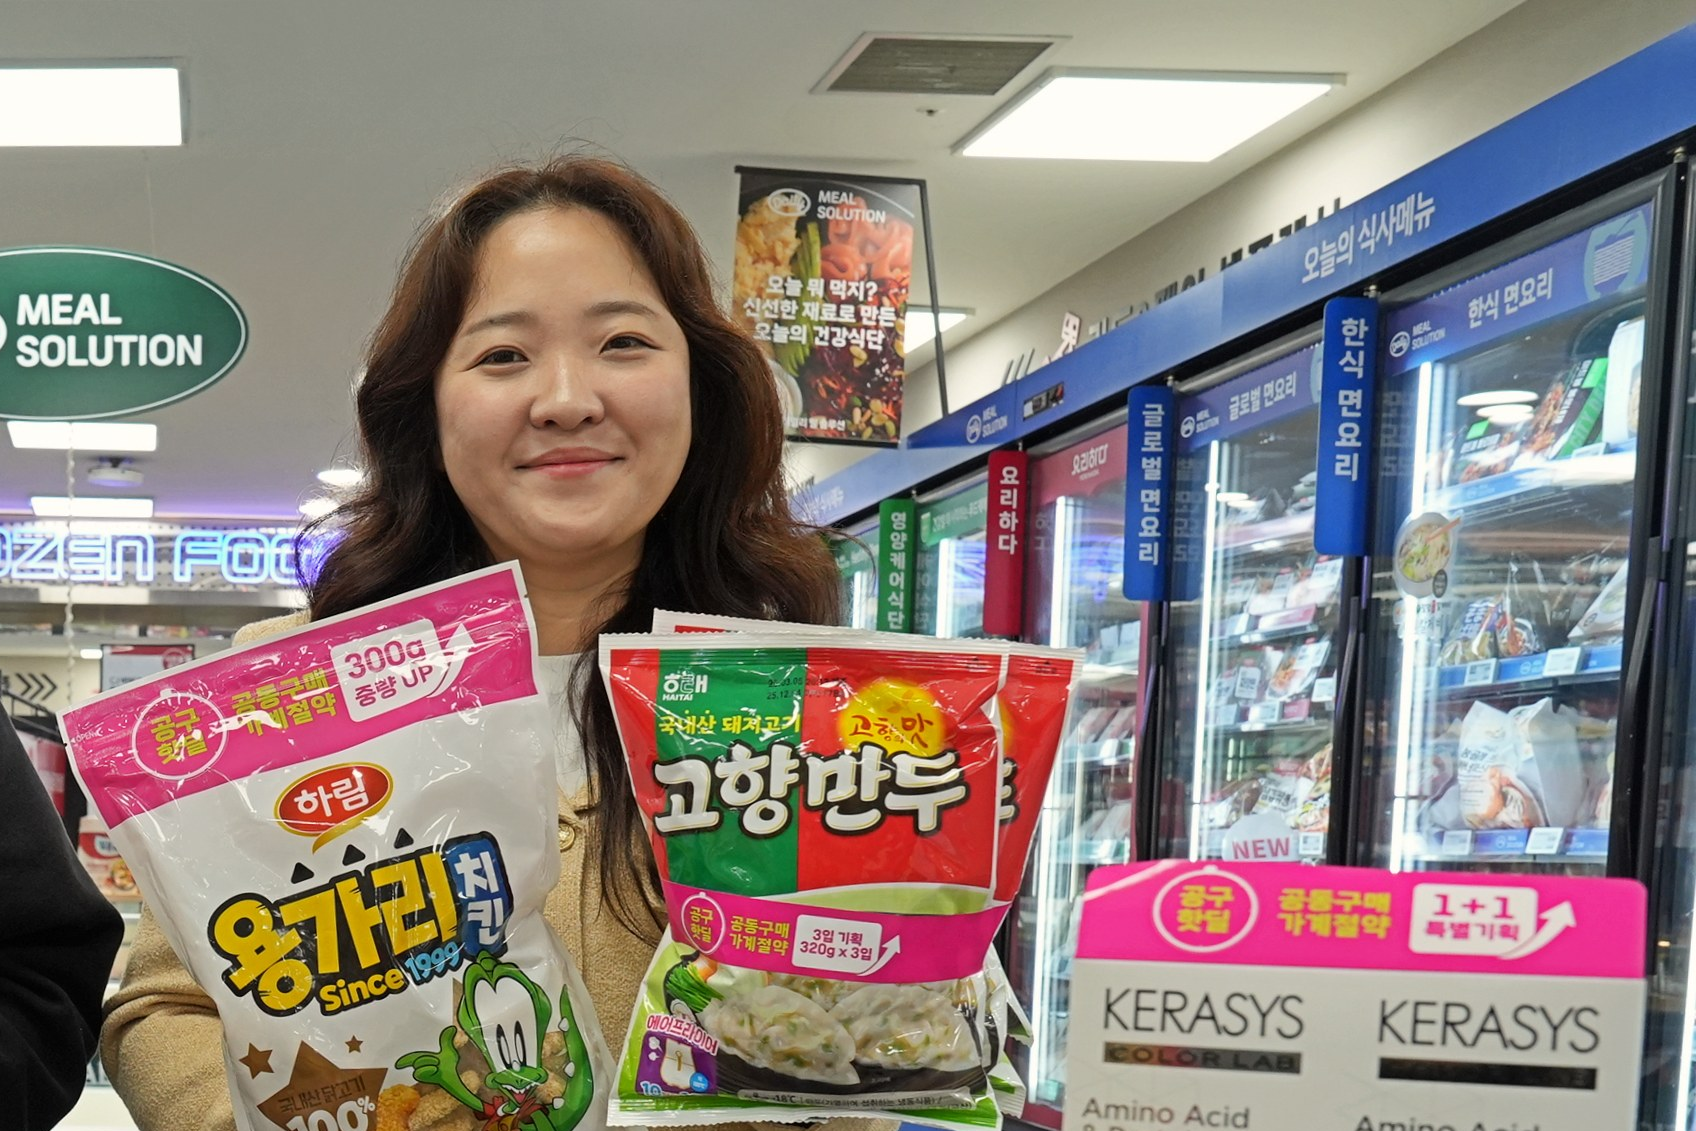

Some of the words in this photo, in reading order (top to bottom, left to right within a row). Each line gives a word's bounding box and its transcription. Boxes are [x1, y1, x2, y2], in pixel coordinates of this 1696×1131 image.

[818, 189, 856, 205] MEAL
[816, 206, 887, 223] SOLUTION
[1300, 224, 1355, 284] 오늘의
[1357, 191, 1436, 256] 식사메뉴
[765, 275, 803, 297] 오늘
[806, 278, 825, 299] 뭐
[829, 278, 878, 302] 먹지?
[1467, 289, 1500, 330] 한식
[1503, 267, 1554, 314] 면요리
[15, 293, 122, 326] MEAL
[742, 297, 799, 320] 신선한
[802, 301, 857, 323] 재료로
[860, 303, 897, 328] 만든
[753, 322, 808, 344] 오늘의
[813, 324, 886, 350] 건강식단
[1411, 327, 1446, 350] SOLUTION
[1412, 320, 1431, 335] MEAL
[15, 333, 203, 368] SOLUTION
[1338, 316, 1369, 380] 한식
[1140, 402, 1166, 482] 글로벌
[1334, 389, 1363, 482] 면요리
[998, 465, 1020, 555] 요리하다
[1138, 488, 1162, 566] 면요리
[887, 510, 908, 631] 영양케어식단
[402, 662, 435, 690] UP
[662, 693, 694, 701] HAITAI
[659, 712, 716, 736] 국내산
[292, 776, 374, 820] 하림
[652, 741, 970, 838] 고향만두
[1232, 836, 1291, 860] NEW
[453, 851, 501, 948] 치킨
[1178, 884, 1234, 909] 공구
[1277, 886, 1392, 914] 공동구매
[1432, 893, 1515, 920] 1+1
[210, 850, 462, 1008] 용가리
[689, 907, 714, 926] 공구
[730, 915, 791, 938] 공동구매
[1176, 906, 1232, 933] 핫딜
[1277, 910, 1393, 939] 가계절약
[689, 924, 713, 945] 핫딜
[729, 933, 790, 957] 가계절약
[812, 928, 835, 943] 3입
[838, 929, 865, 949] 기획
[800, 940, 835, 960] 320g
[850, 944, 873, 963] 3입
[318, 967, 404, 1014] Since
[404, 940, 464, 986] 1999
[1103, 986, 1305, 1039] KERASYS
[1378, 997, 1602, 1055] KERASYS
[1107, 1045, 1229, 1068] COLOR
[1233, 1051, 1297, 1072] LAB
[277, 1088, 322, 1115] 국내산
[1081, 1097, 1175, 1126] Amino
[1183, 1104, 1251, 1130] Acid
